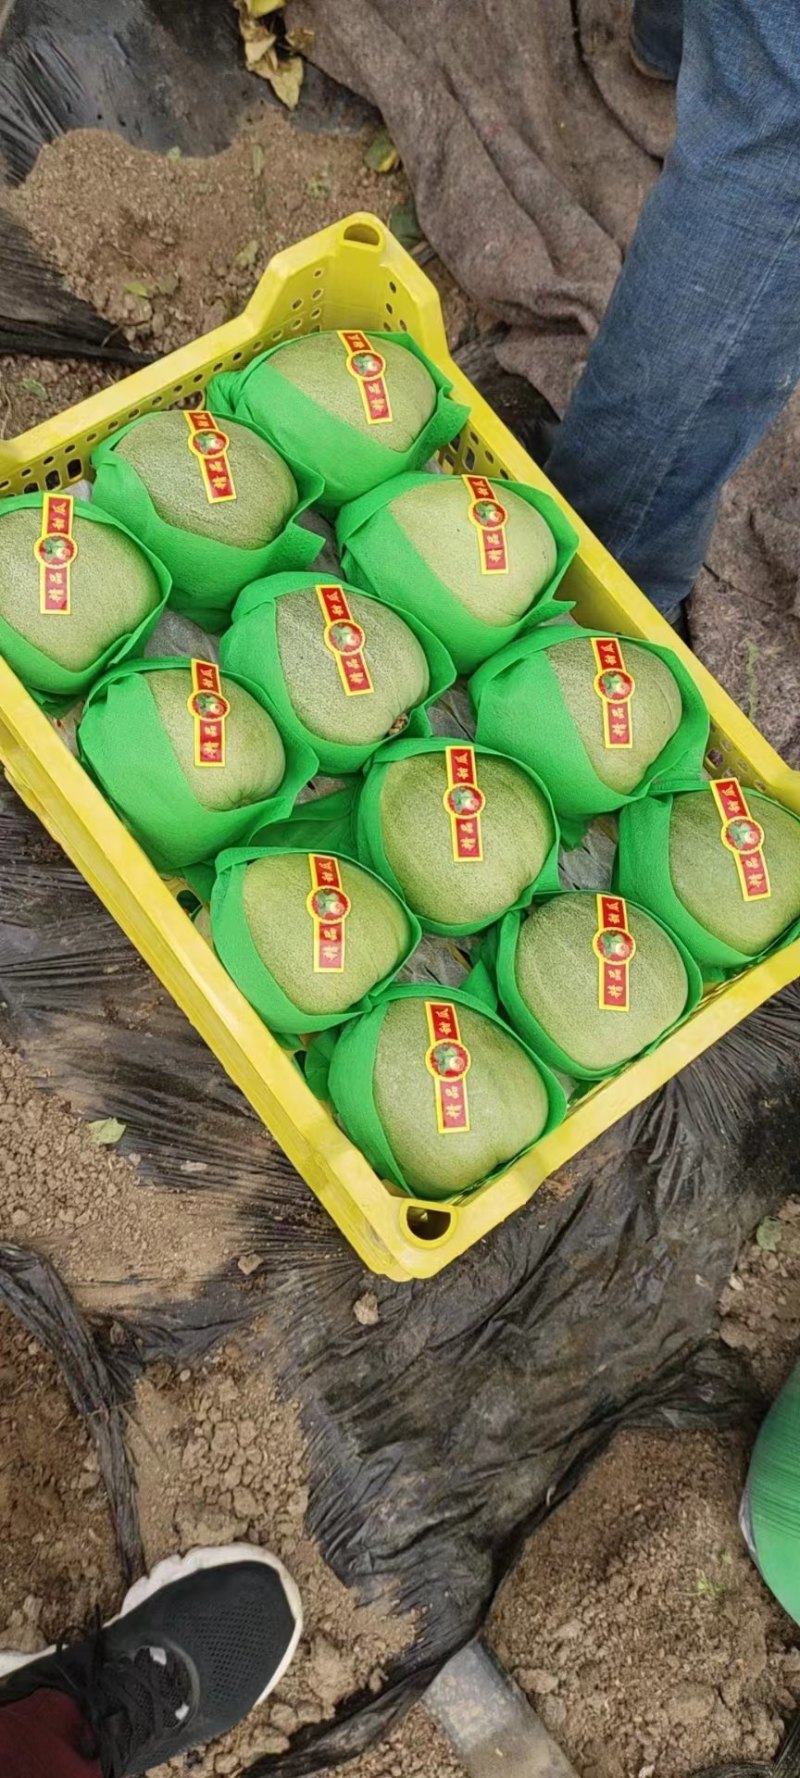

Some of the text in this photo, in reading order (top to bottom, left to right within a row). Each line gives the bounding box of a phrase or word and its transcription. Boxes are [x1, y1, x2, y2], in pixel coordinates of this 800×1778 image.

[367, 382, 385, 412] 精品
[208, 461, 228, 490] 精品
[47, 502, 70, 602] 精品 甜瓜
[485, 532, 504, 563] 精品
[325, 590, 365, 686] 精品 甜瓜
[201, 666, 221, 759] 精品 甜瓜
[600, 643, 628, 738] 精品 甜瓜
[455, 751, 477, 851] 精品 甜瓜
[721, 787, 765, 888] 精品 甜瓜
[318, 861, 339, 962] 精品 甜瓜
[607, 901, 624, 1001] 精品 甜瓜
[436, 1007, 463, 1120] 精品 甜瓜
